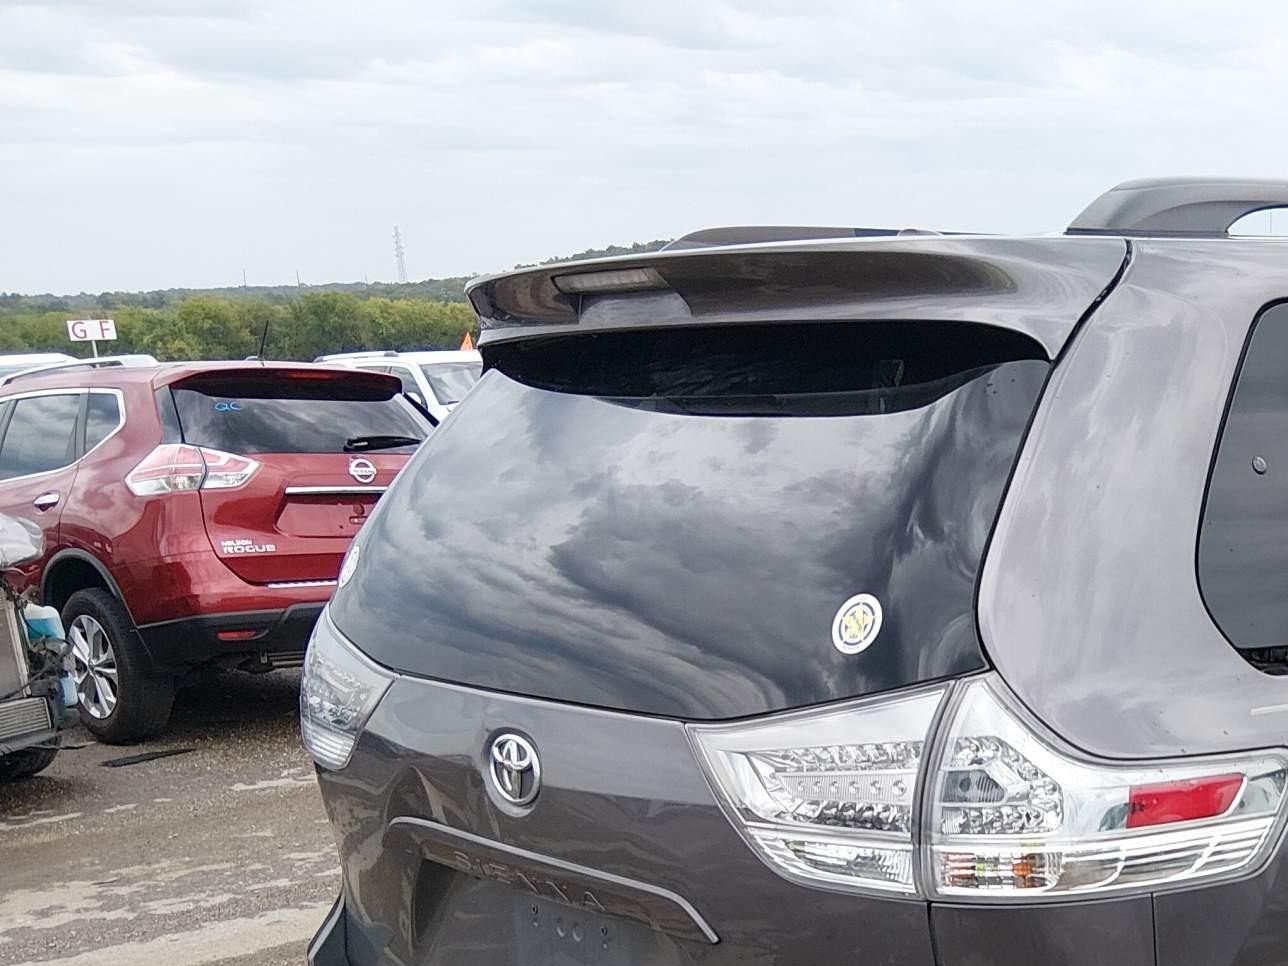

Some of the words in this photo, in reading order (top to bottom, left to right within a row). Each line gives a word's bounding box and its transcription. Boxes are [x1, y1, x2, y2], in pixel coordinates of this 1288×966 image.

[71, 321, 88, 339] G
[99, 320, 111, 338] F
[223, 544, 276, 554] ROGUE
